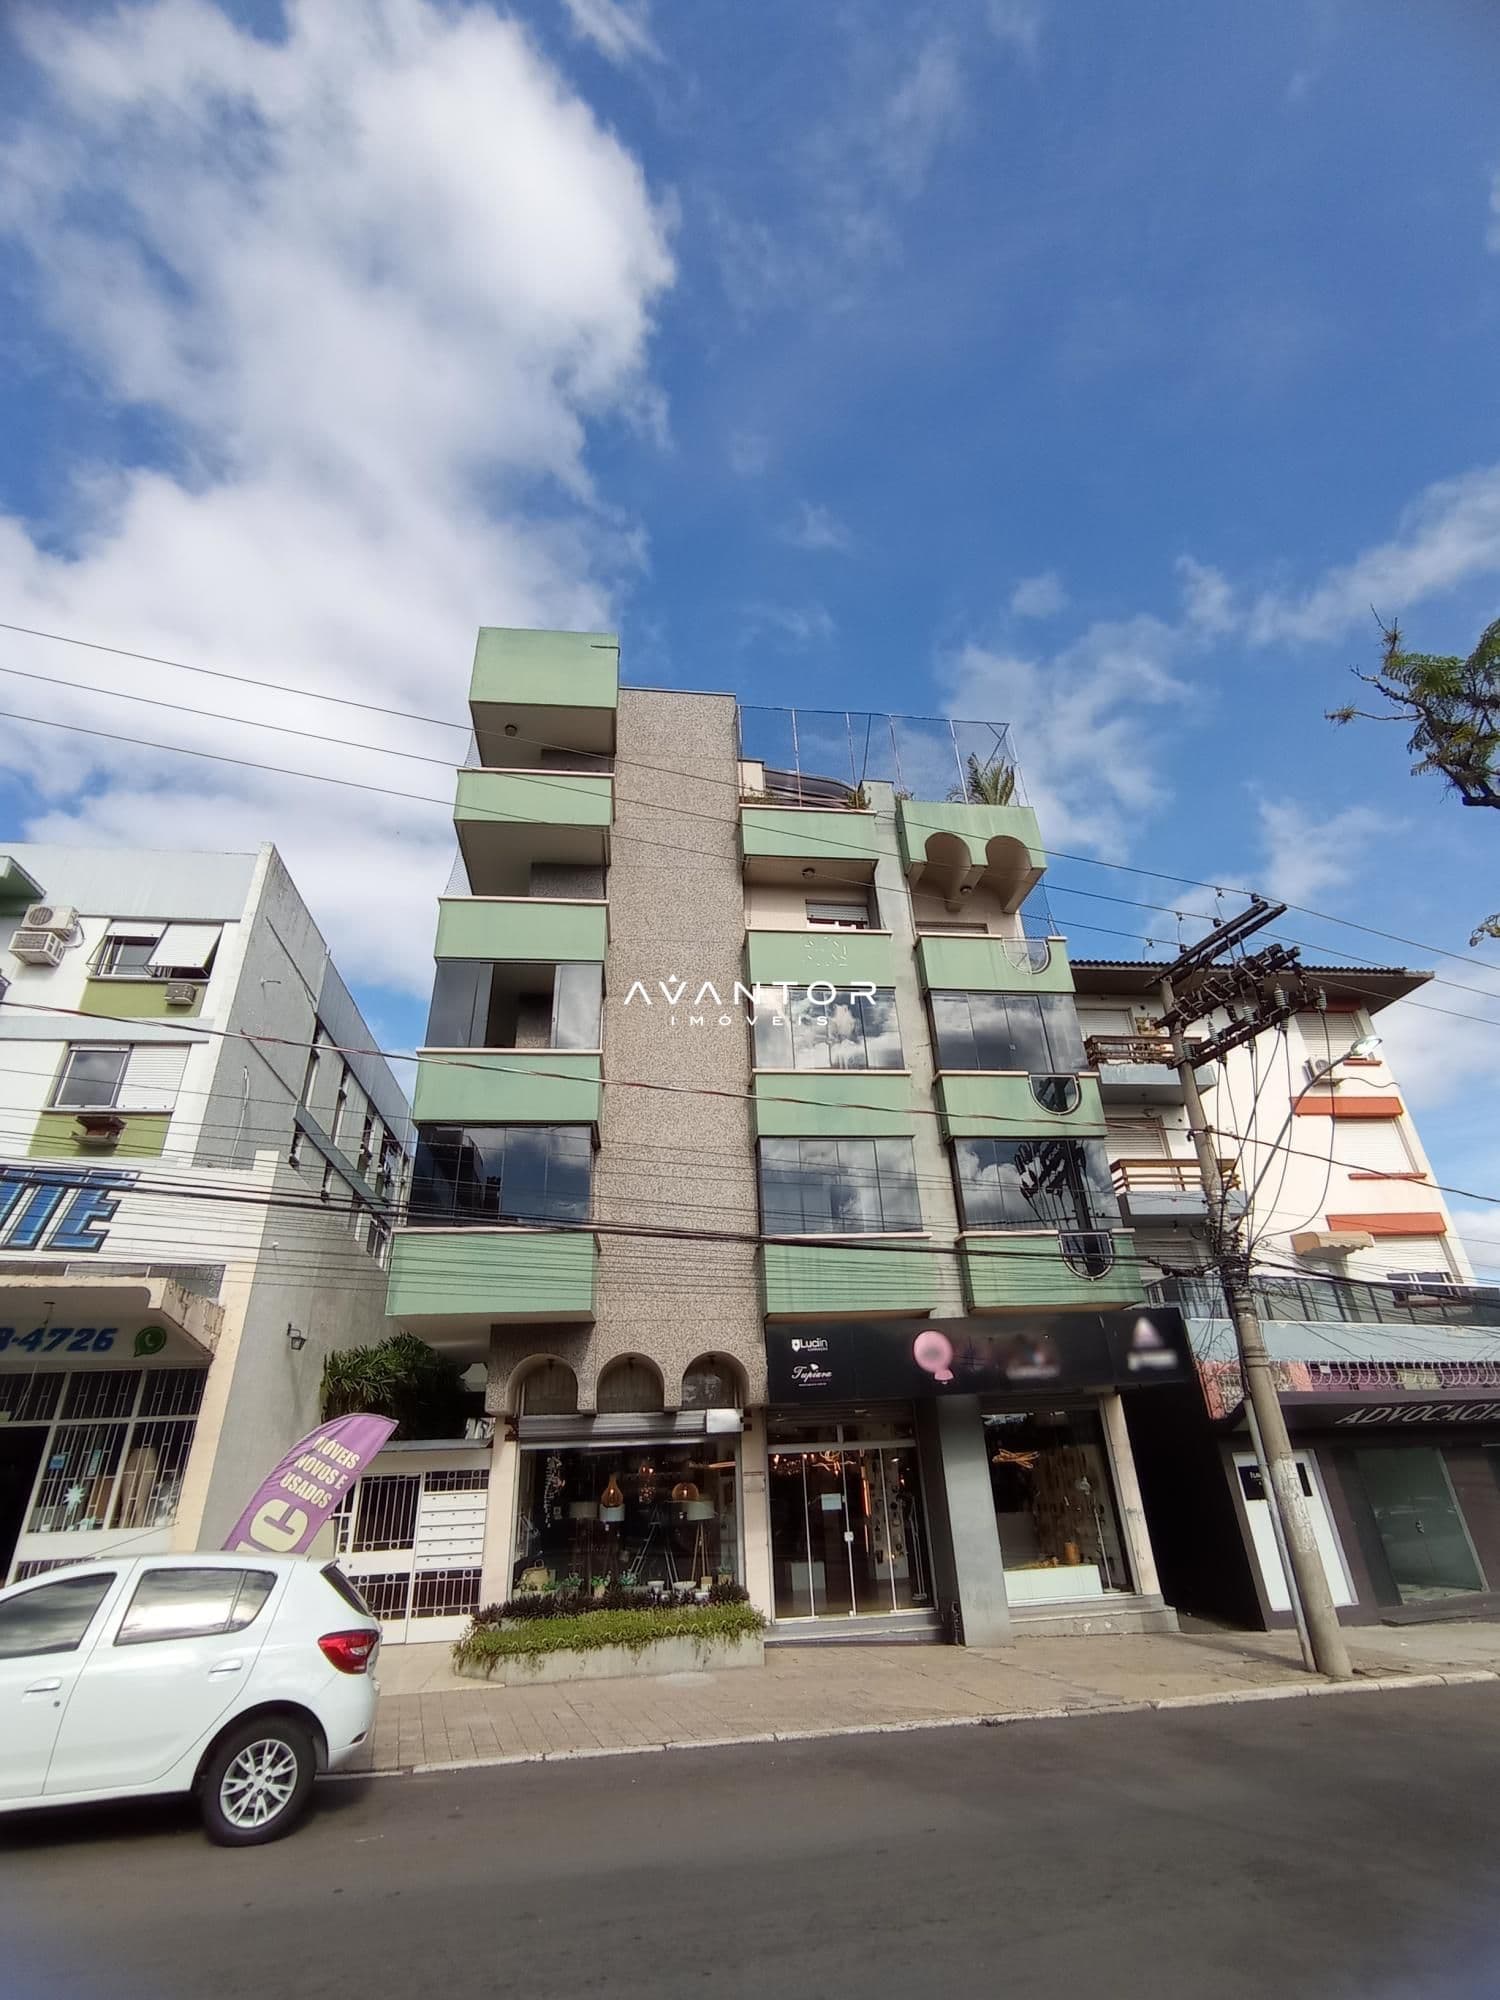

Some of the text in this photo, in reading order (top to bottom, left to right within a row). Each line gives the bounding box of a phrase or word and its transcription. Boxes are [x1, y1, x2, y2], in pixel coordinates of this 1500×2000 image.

[294, 1453, 349, 1490] NOVOS E
[312, 1436, 360, 1470] MÓVEIS
[279, 1471, 333, 1509] USADOS
